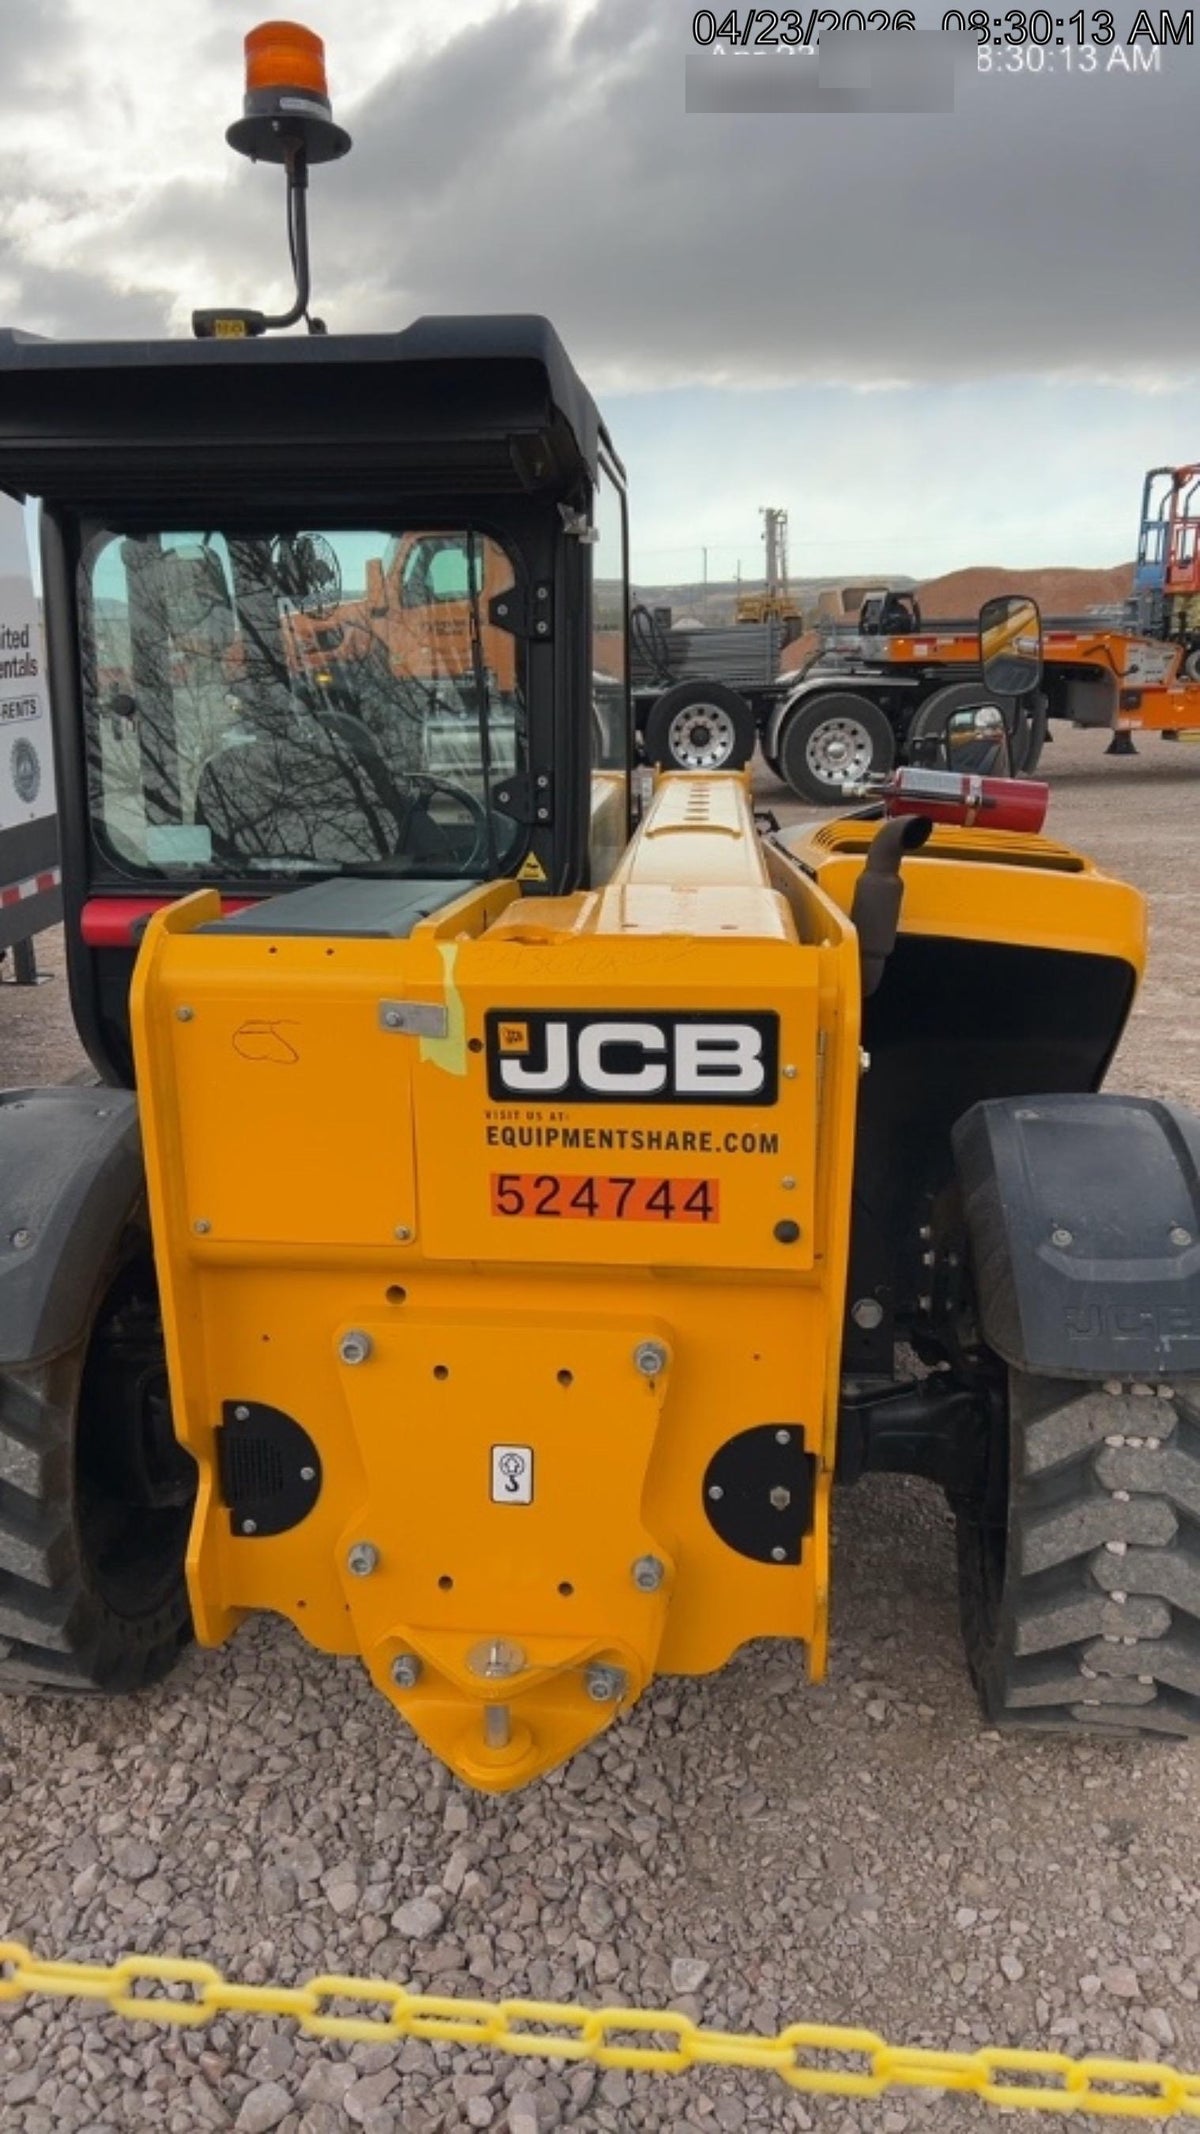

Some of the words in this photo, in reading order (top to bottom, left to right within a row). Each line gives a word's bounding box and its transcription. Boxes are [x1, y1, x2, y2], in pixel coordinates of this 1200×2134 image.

[0, 623, 30, 650] ited
[500, 1021, 766, 1093] JCB
[485, 1109, 520, 1121] VISIT
[525, 1111, 543, 1121] US
[486, 1125, 779, 1154] EQUIPMENTSHARE.COM
[496, 1174, 714, 1222] 524744
